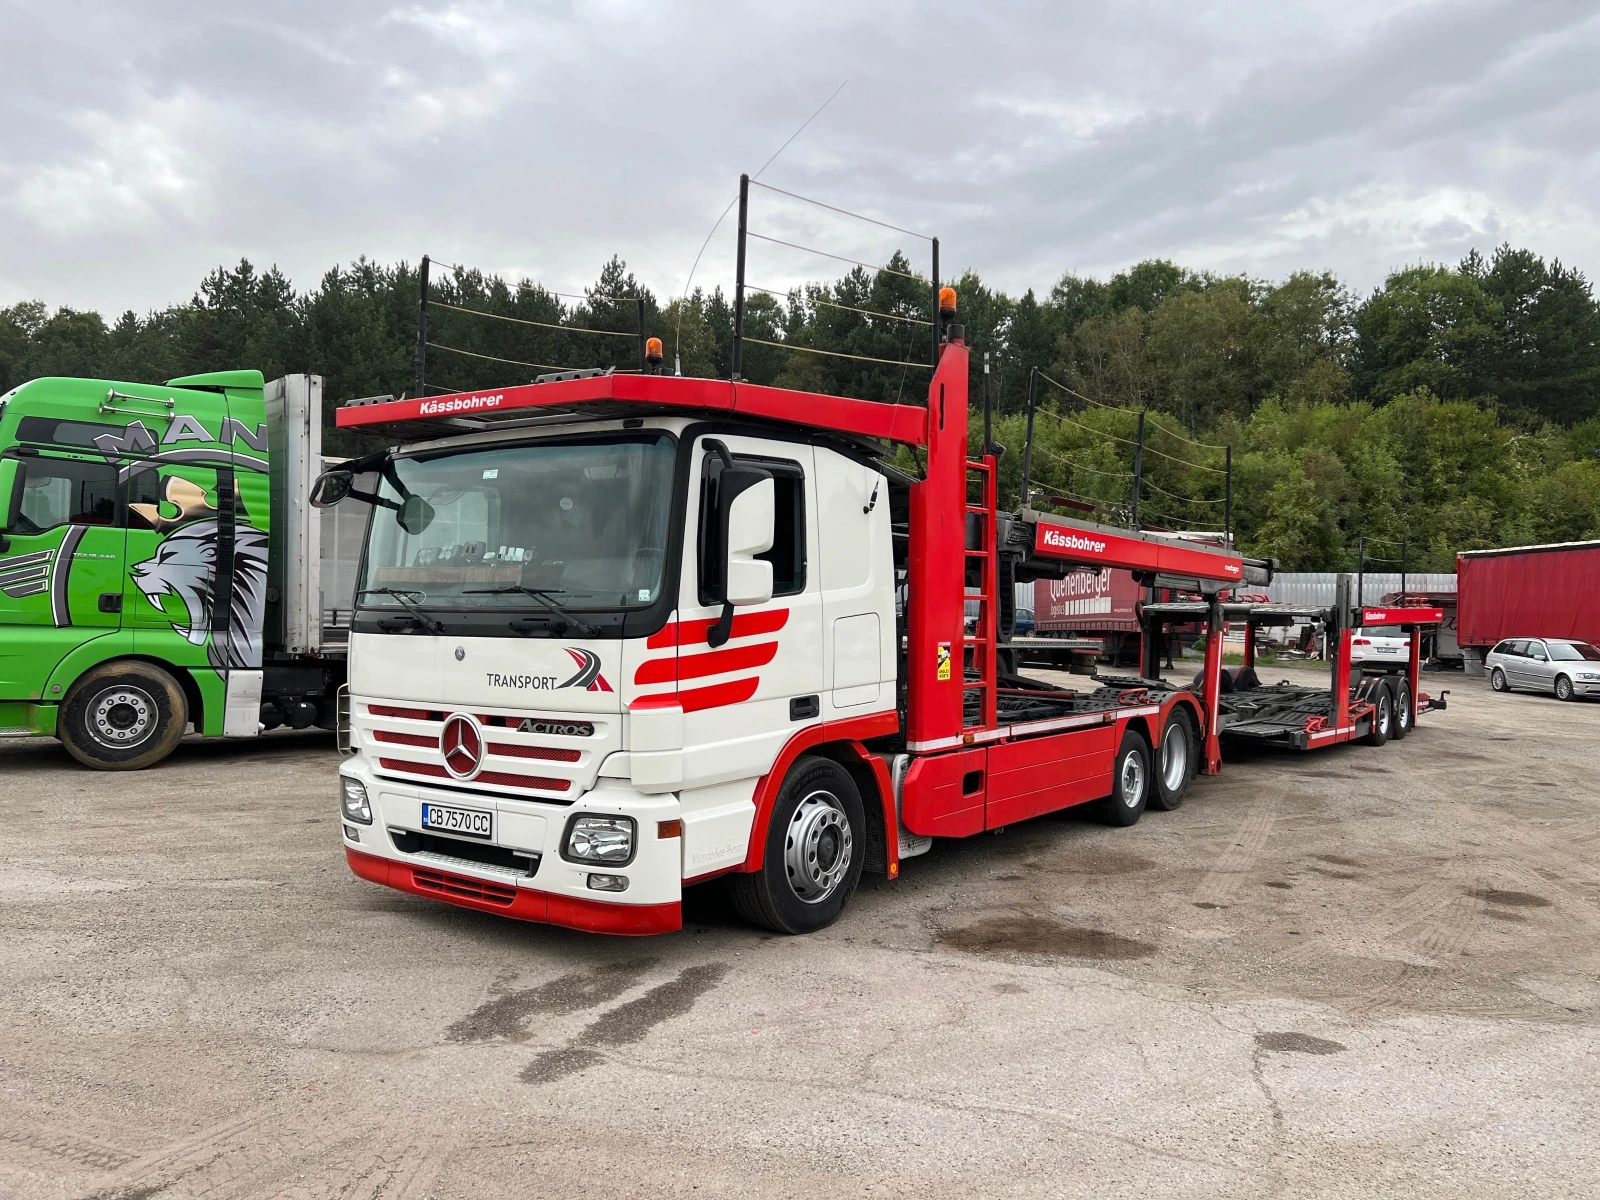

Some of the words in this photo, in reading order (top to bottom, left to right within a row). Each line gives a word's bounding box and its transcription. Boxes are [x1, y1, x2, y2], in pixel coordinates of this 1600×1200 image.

[420, 394, 504, 414] Kässbohrer
[92, 414, 268, 465] MAN
[1044, 530, 1106, 553] Kässbohrer
[486, 673, 557, 690] TRANSPORT
